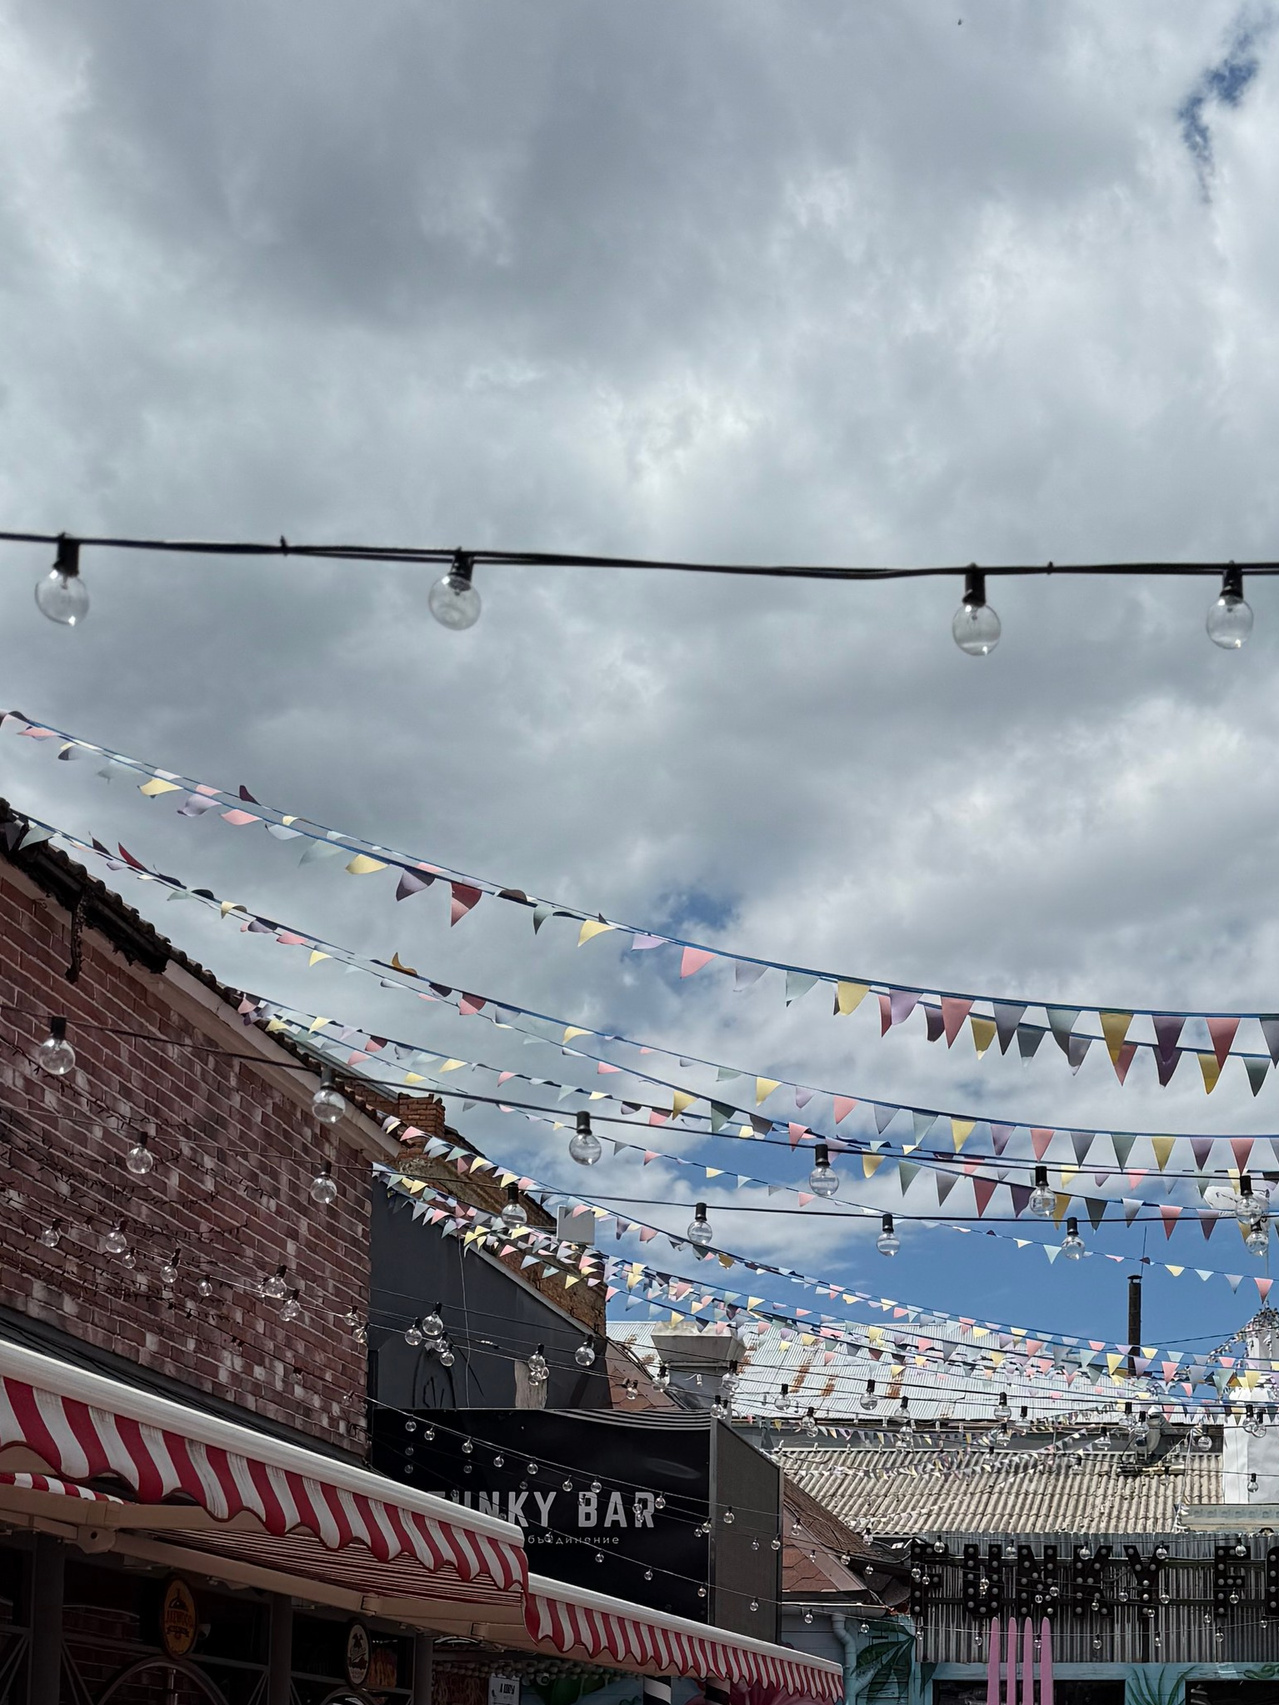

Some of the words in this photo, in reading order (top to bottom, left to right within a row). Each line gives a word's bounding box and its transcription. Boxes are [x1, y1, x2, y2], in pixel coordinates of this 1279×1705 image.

[425, 1491, 557, 1528] NKY
[578, 1491, 655, 1528] BAR
[527, 1535, 620, 1545] бъдинение
[910, 1543, 1170, 1618] FUNKY
